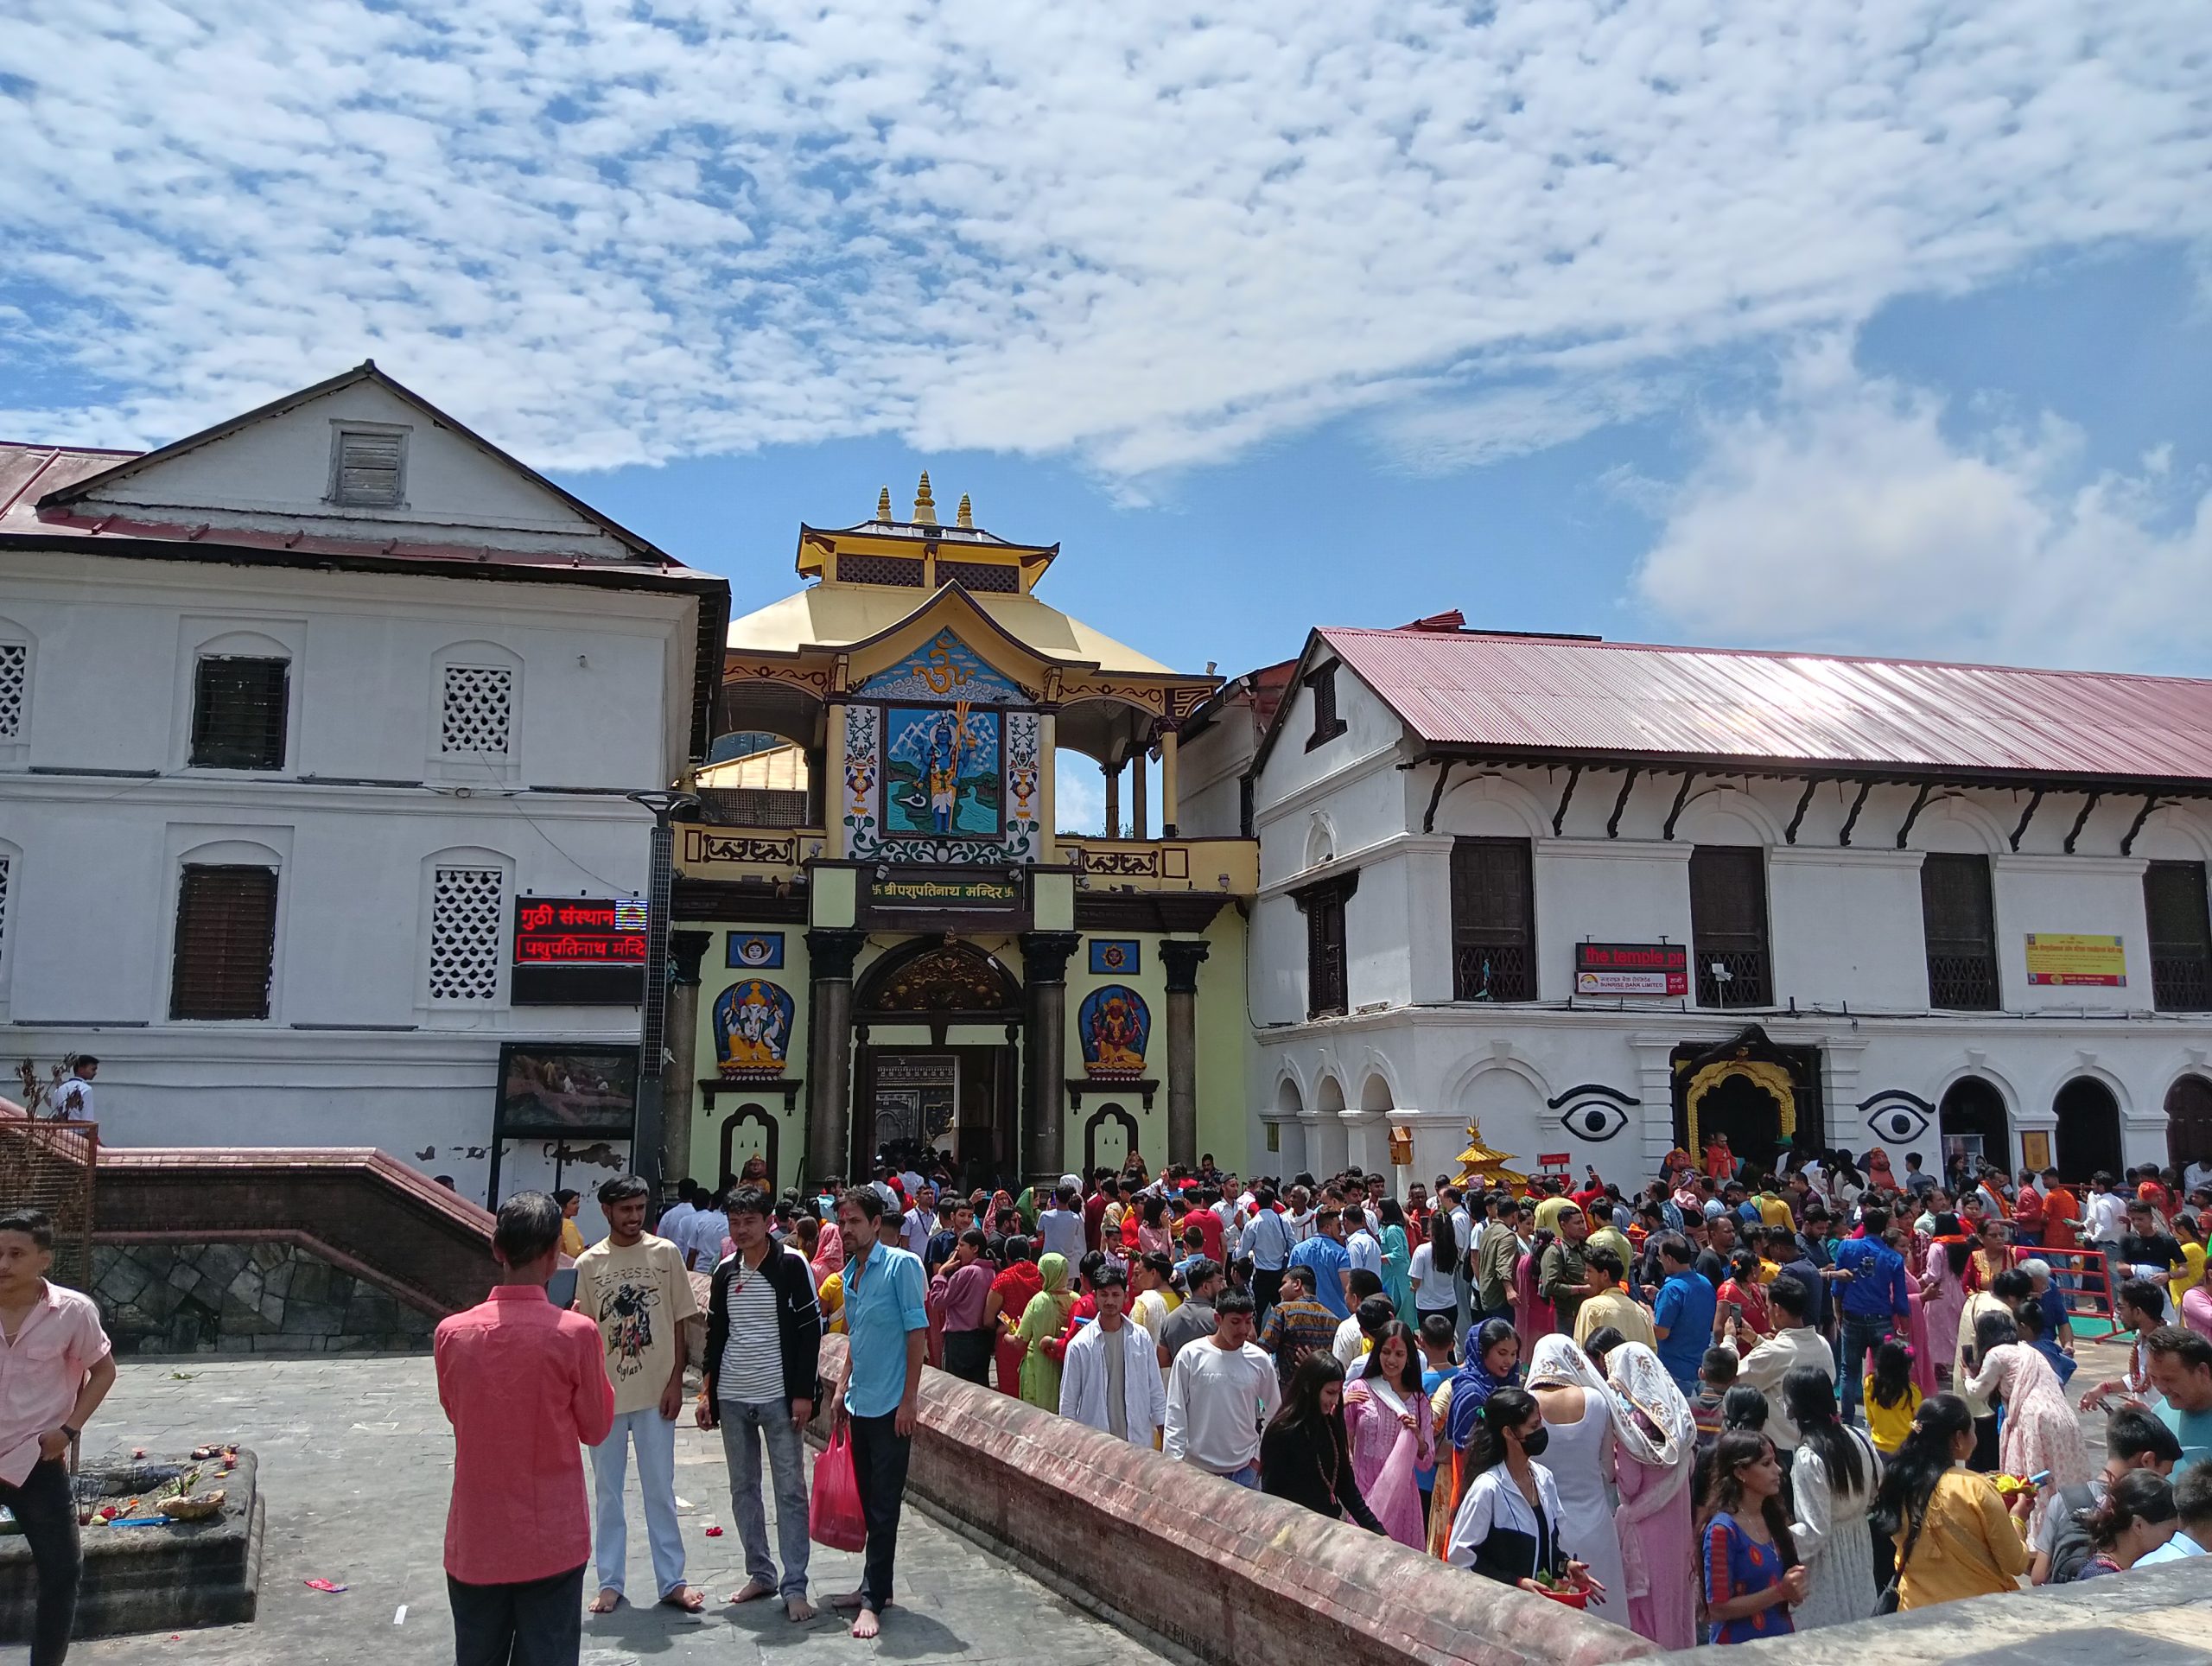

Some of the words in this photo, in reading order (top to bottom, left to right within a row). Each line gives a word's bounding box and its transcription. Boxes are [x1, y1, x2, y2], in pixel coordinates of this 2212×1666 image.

[965, 882, 1003, 899] मन्दिर
[520, 904, 555, 931] गुठी
[558, 905, 615, 926] संस्थान
[524, 937, 607, 961] पशुपतिनाथ
[1586, 946, 1610, 963] the
[1613, 948, 1664, 966] temple
